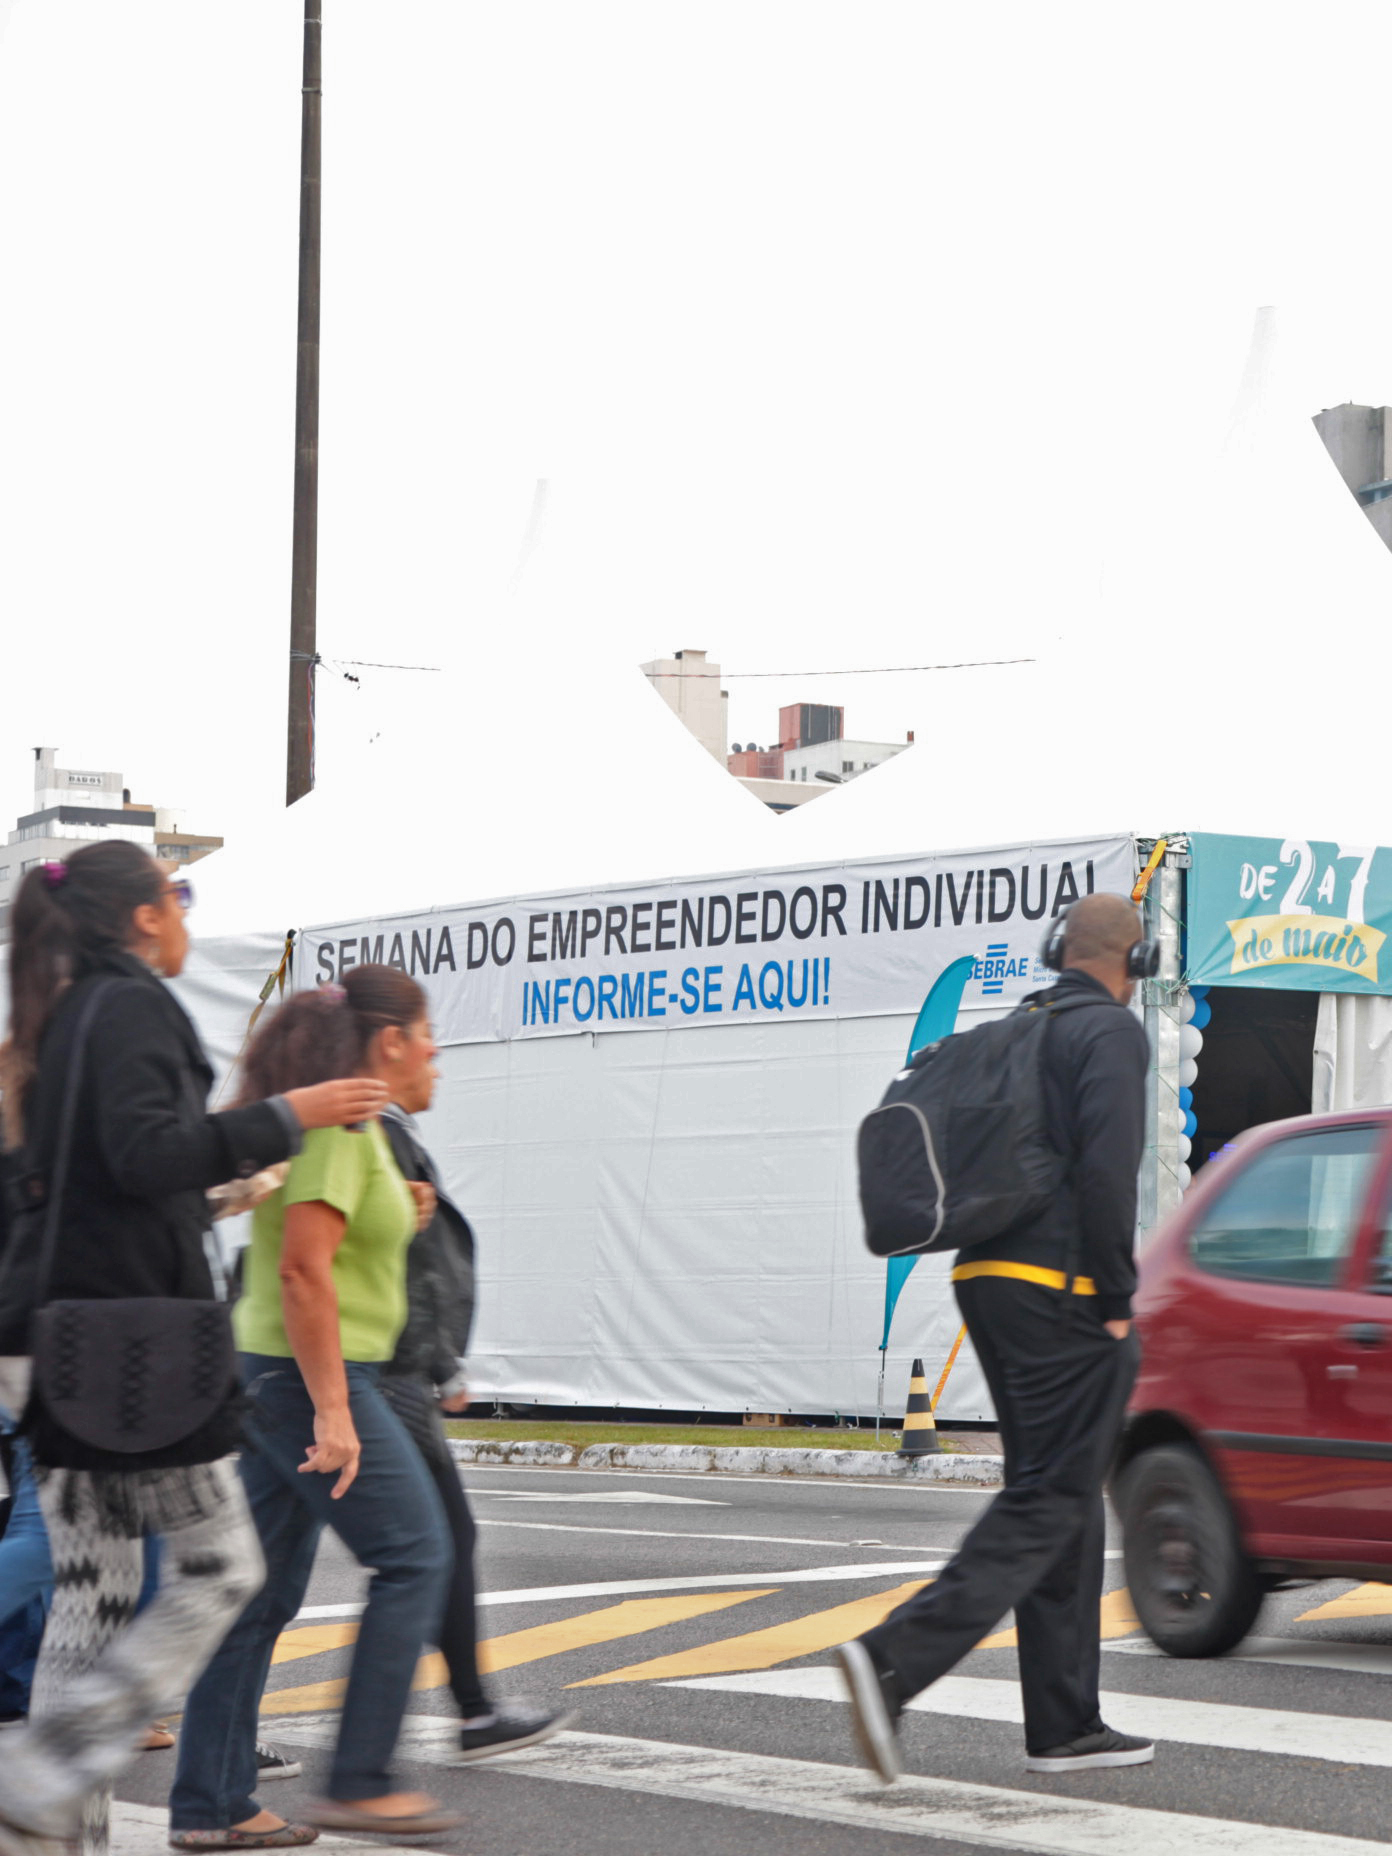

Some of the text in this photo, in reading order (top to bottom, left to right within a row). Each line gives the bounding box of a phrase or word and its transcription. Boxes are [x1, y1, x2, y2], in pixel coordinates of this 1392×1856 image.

[1239, 839, 1377, 924] DE 2 A 7
[315, 925, 457, 987] SEMANA
[467, 916, 516, 970] DO
[527, 884, 847, 963] EMPREENDEDOR
[1242, 924, 1368, 968] de maio
[522, 957, 830, 1025] INFORME-SE AQUI!
